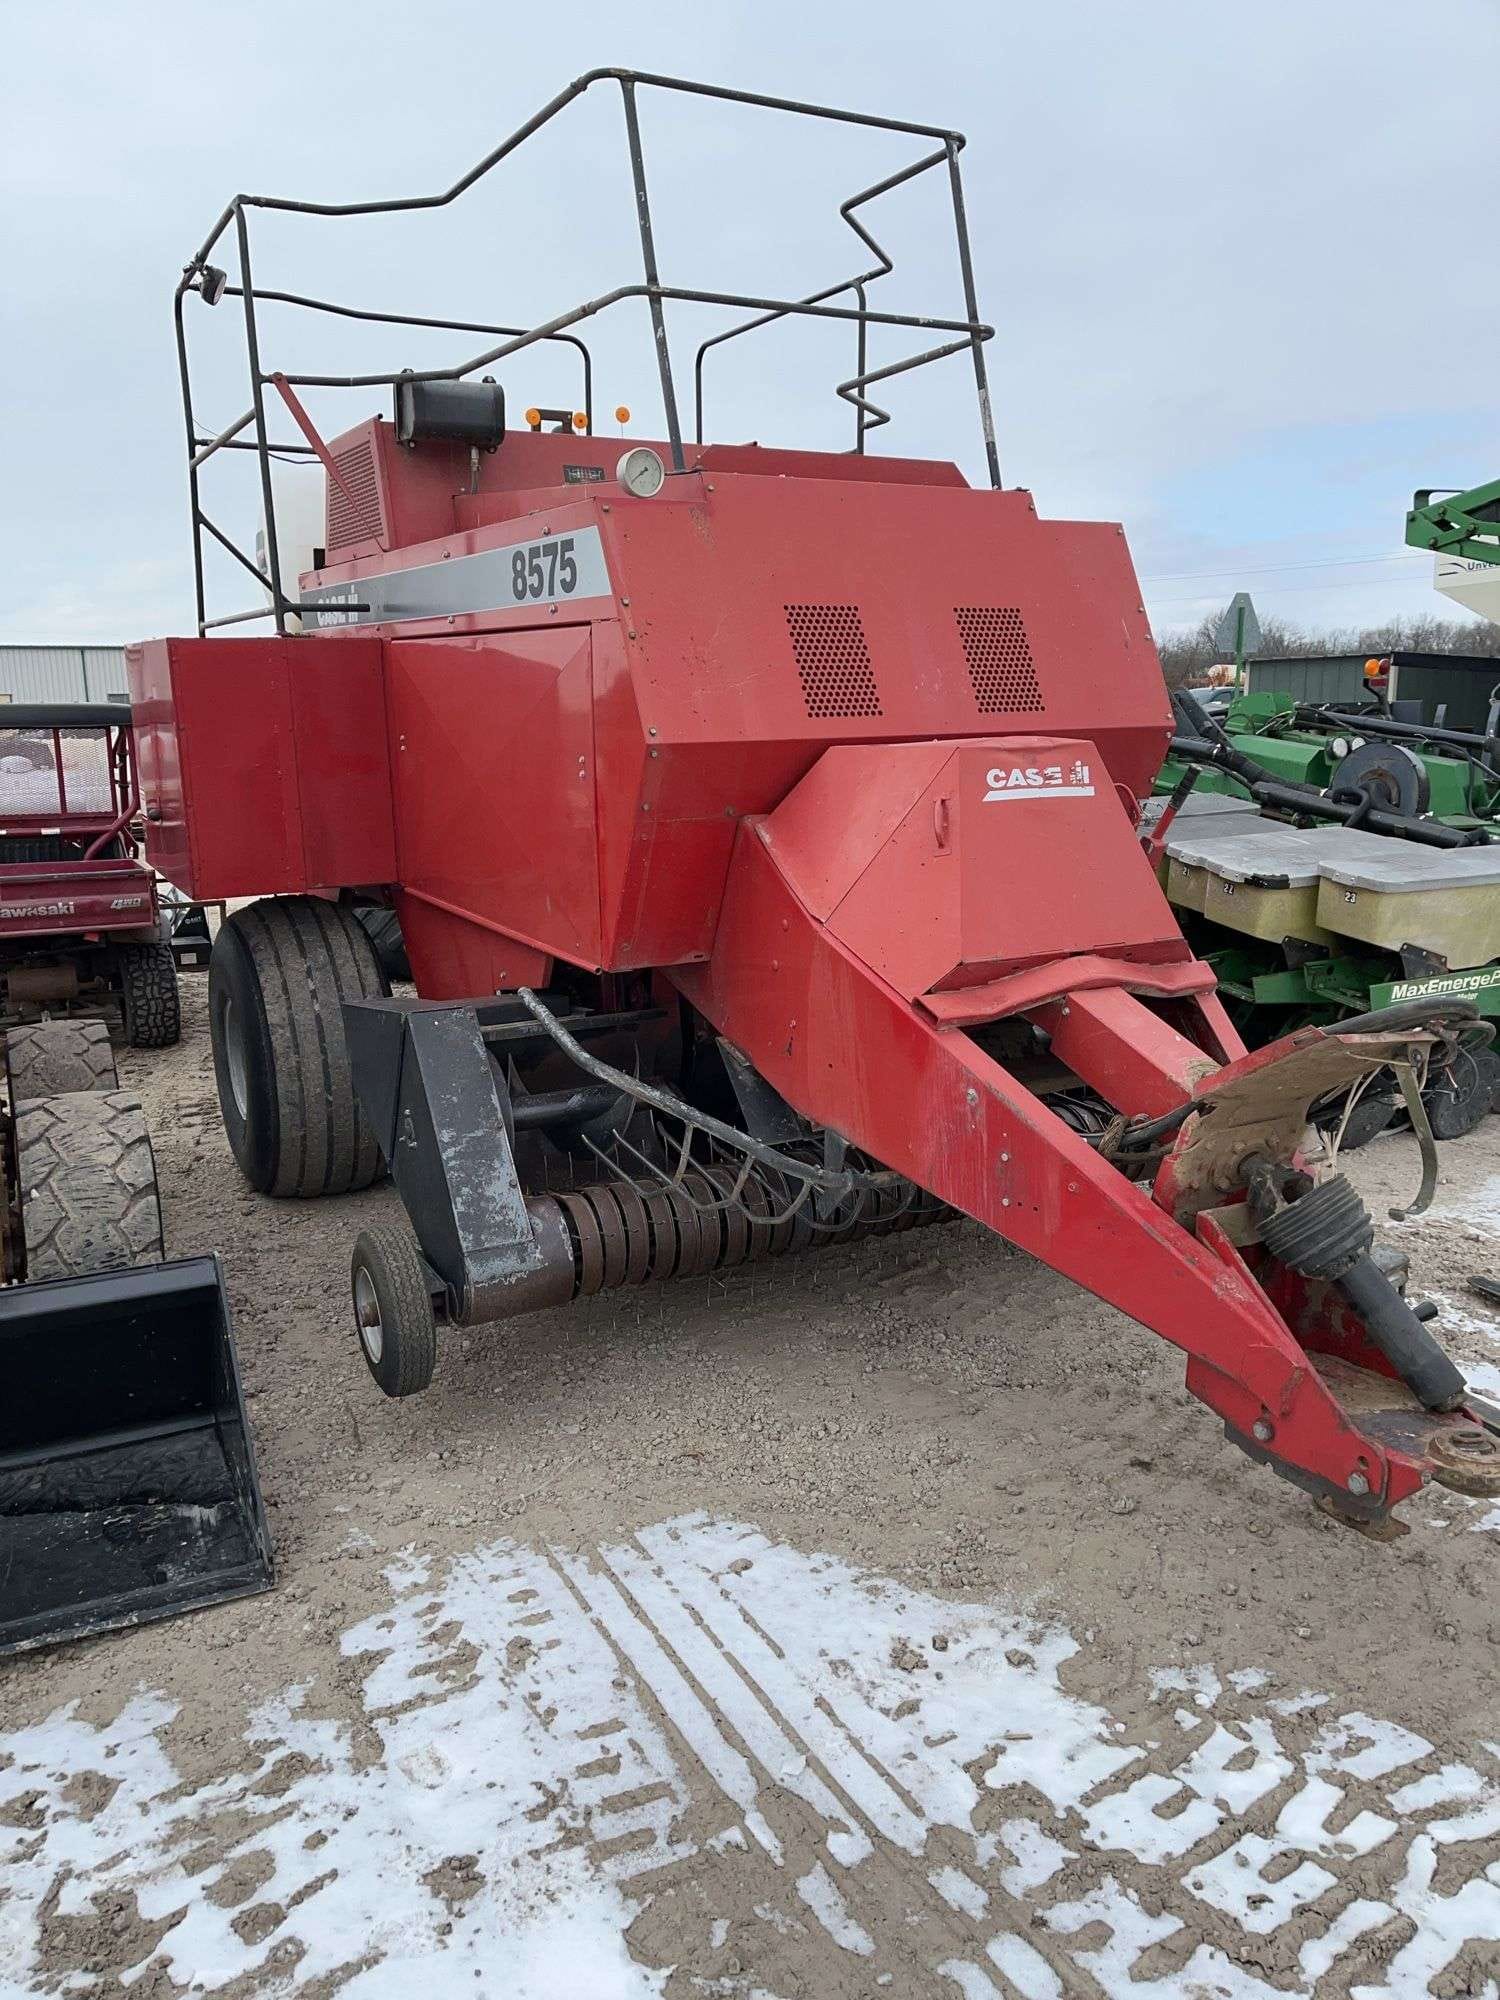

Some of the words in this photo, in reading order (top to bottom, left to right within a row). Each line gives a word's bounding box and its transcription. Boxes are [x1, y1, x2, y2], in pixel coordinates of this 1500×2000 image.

[511, 537, 578, 601] 8575
[985, 766, 1063, 788] CASE
[110, 897, 142, 910] 4WD
[1344, 890, 1357, 904] 23
[0, 901, 75, 919] awasaki
